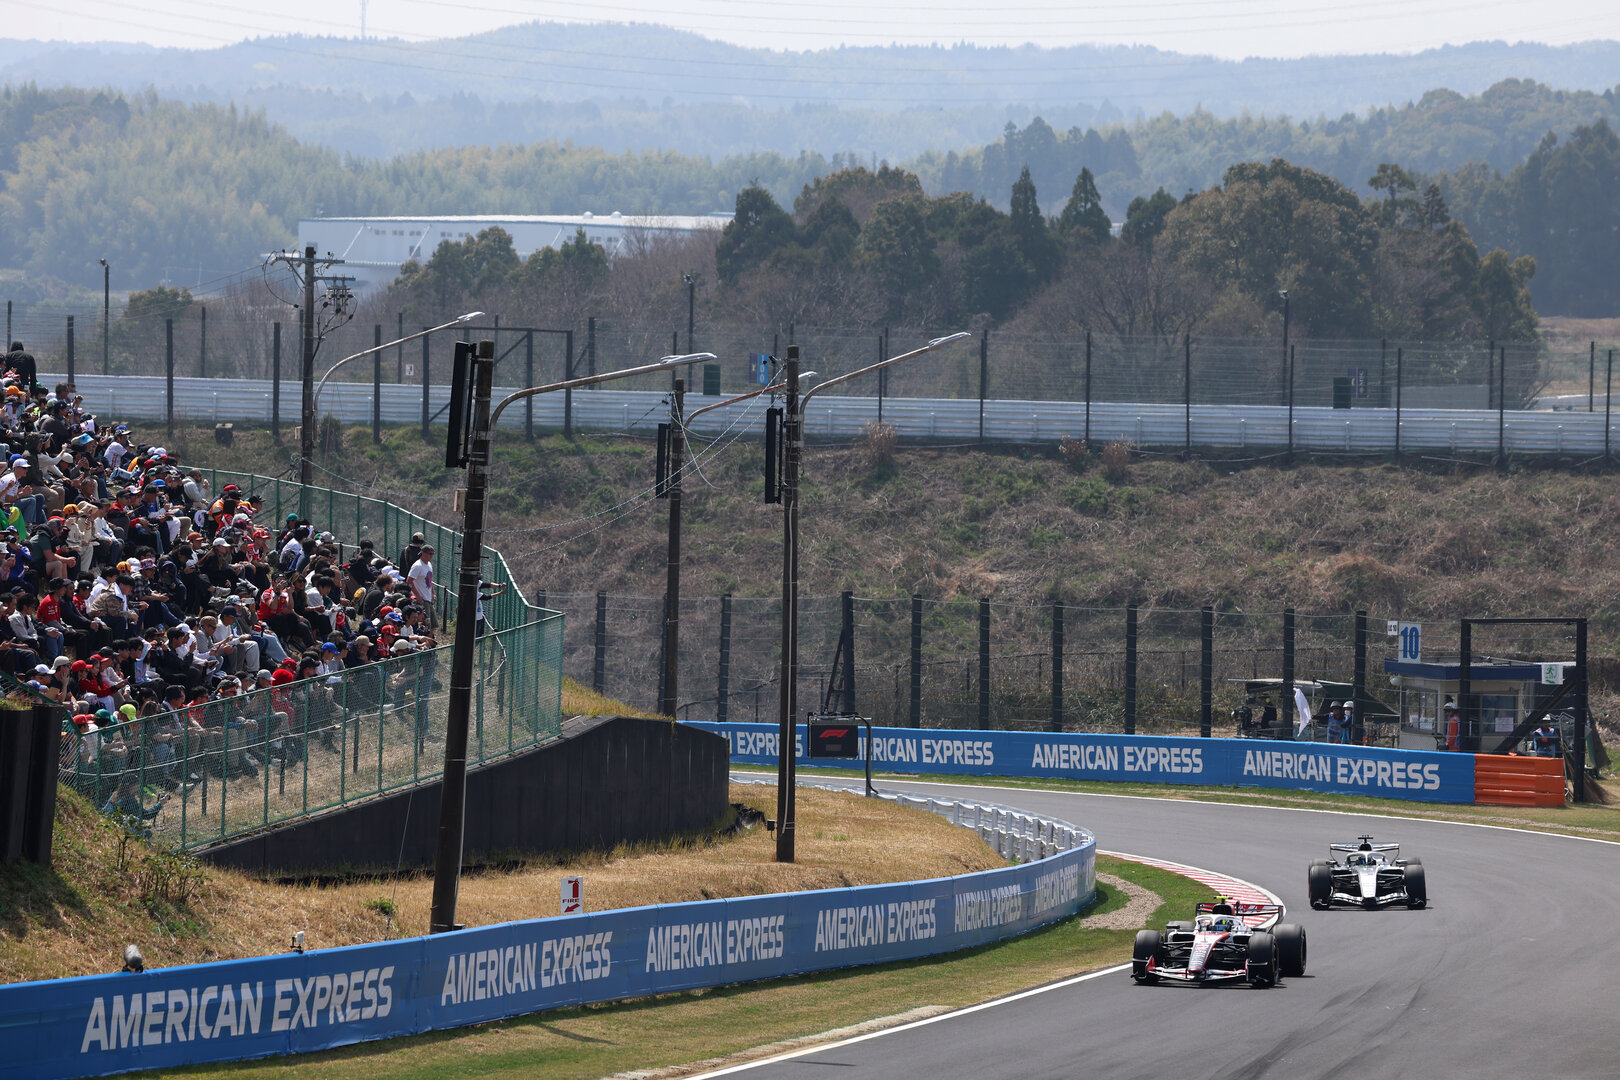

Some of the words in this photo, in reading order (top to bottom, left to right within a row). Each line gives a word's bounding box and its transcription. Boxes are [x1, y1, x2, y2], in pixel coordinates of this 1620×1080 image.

[1401, 626, 1419, 660] 10
[737, 731, 804, 758] EXPRS
[921, 739, 994, 766] EXPRESS
[1031, 743, 1119, 771] AMERICAN
[1123, 746, 1203, 773] EXPRESS
[1243, 750, 1331, 783] AMERICAN
[1336, 758, 1441, 790] EXPRESS
[814, 904, 885, 953] AMERICAN
[887, 898, 936, 944] EXPRESS
[954, 889, 990, 933] AMERICAN
[645, 920, 723, 973] AMERICAN
[726, 914, 785, 964] EXPRESS
[441, 942, 537, 1007] AMERICAN
[541, 931, 613, 988] EXPRESS
[80, 981, 263, 1053] AMERICAN
[271, 966, 395, 1032] EXPRESS
